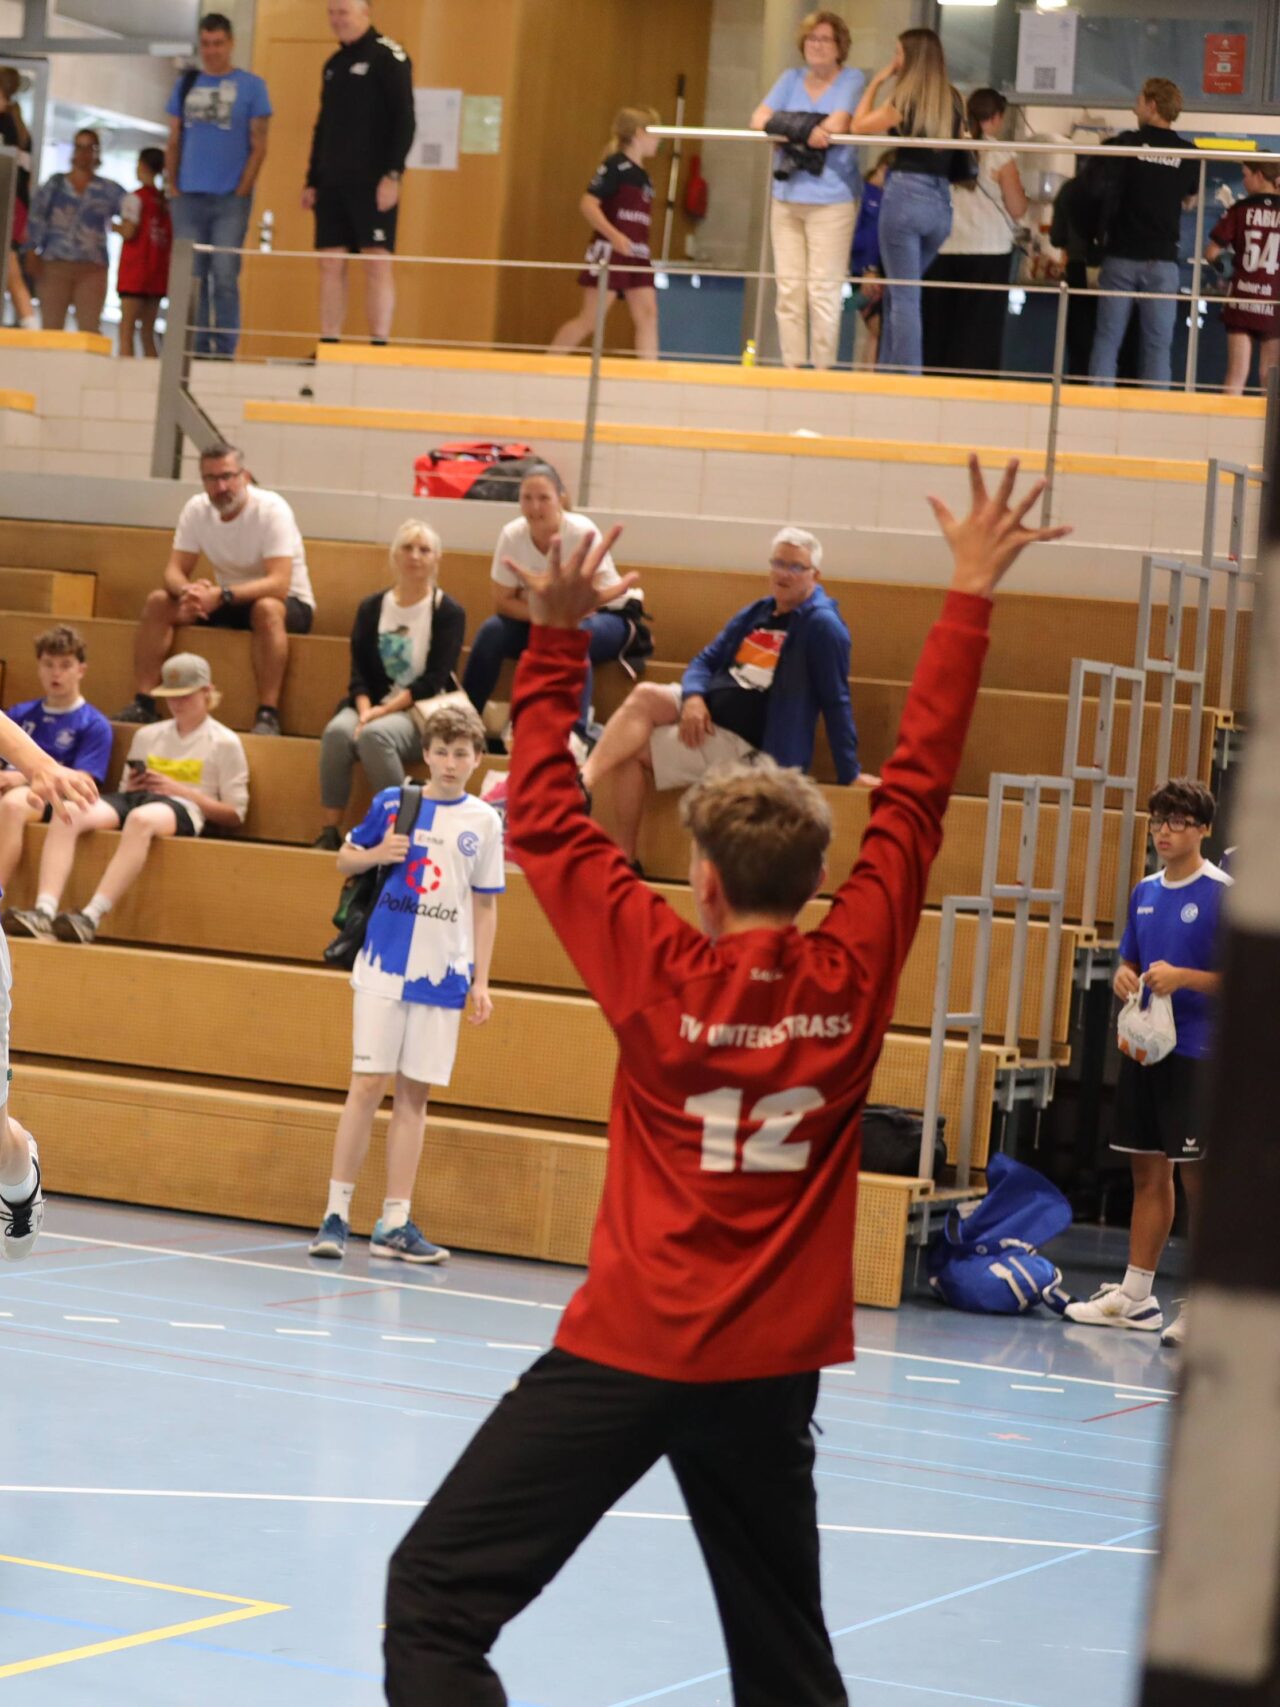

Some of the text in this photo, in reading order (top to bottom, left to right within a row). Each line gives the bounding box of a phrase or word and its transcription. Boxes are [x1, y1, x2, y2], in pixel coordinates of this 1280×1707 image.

[1242, 229, 1280, 275] 54
[379, 892, 458, 923] Polkadot
[679, 1012, 853, 1049] TV UNTERSTRASS
[683, 1085, 826, 1173] 12
